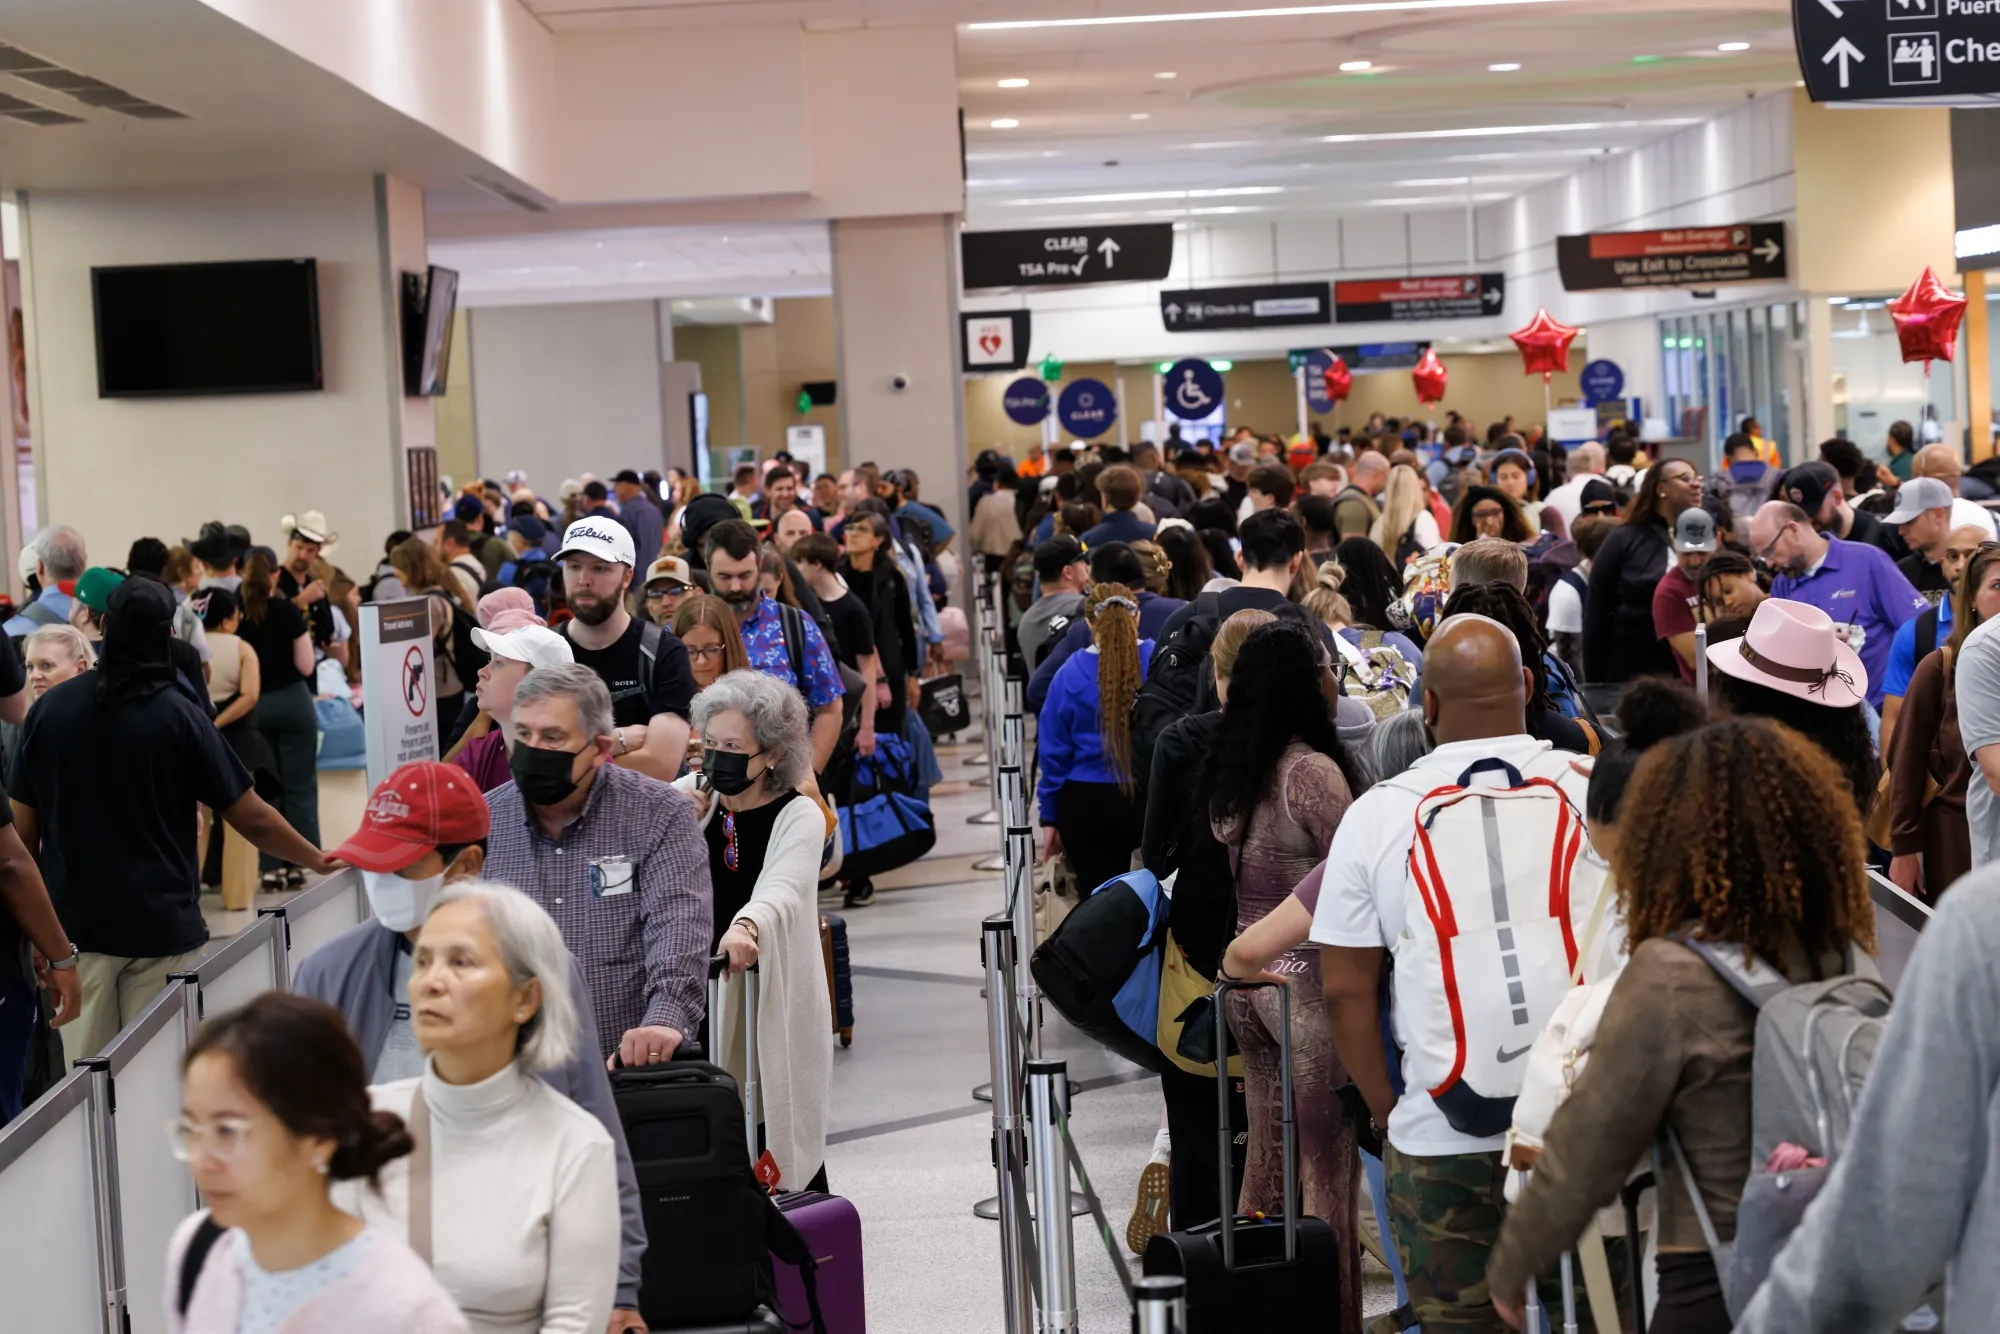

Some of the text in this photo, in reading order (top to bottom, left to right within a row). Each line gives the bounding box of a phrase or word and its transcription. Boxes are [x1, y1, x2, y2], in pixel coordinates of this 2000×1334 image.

[1044, 236, 1089, 251] CLEAR
[1018, 263, 1045, 276] TSA
[1070, 408, 1104, 422] CLEAR
[566, 526, 615, 544] Titleist
